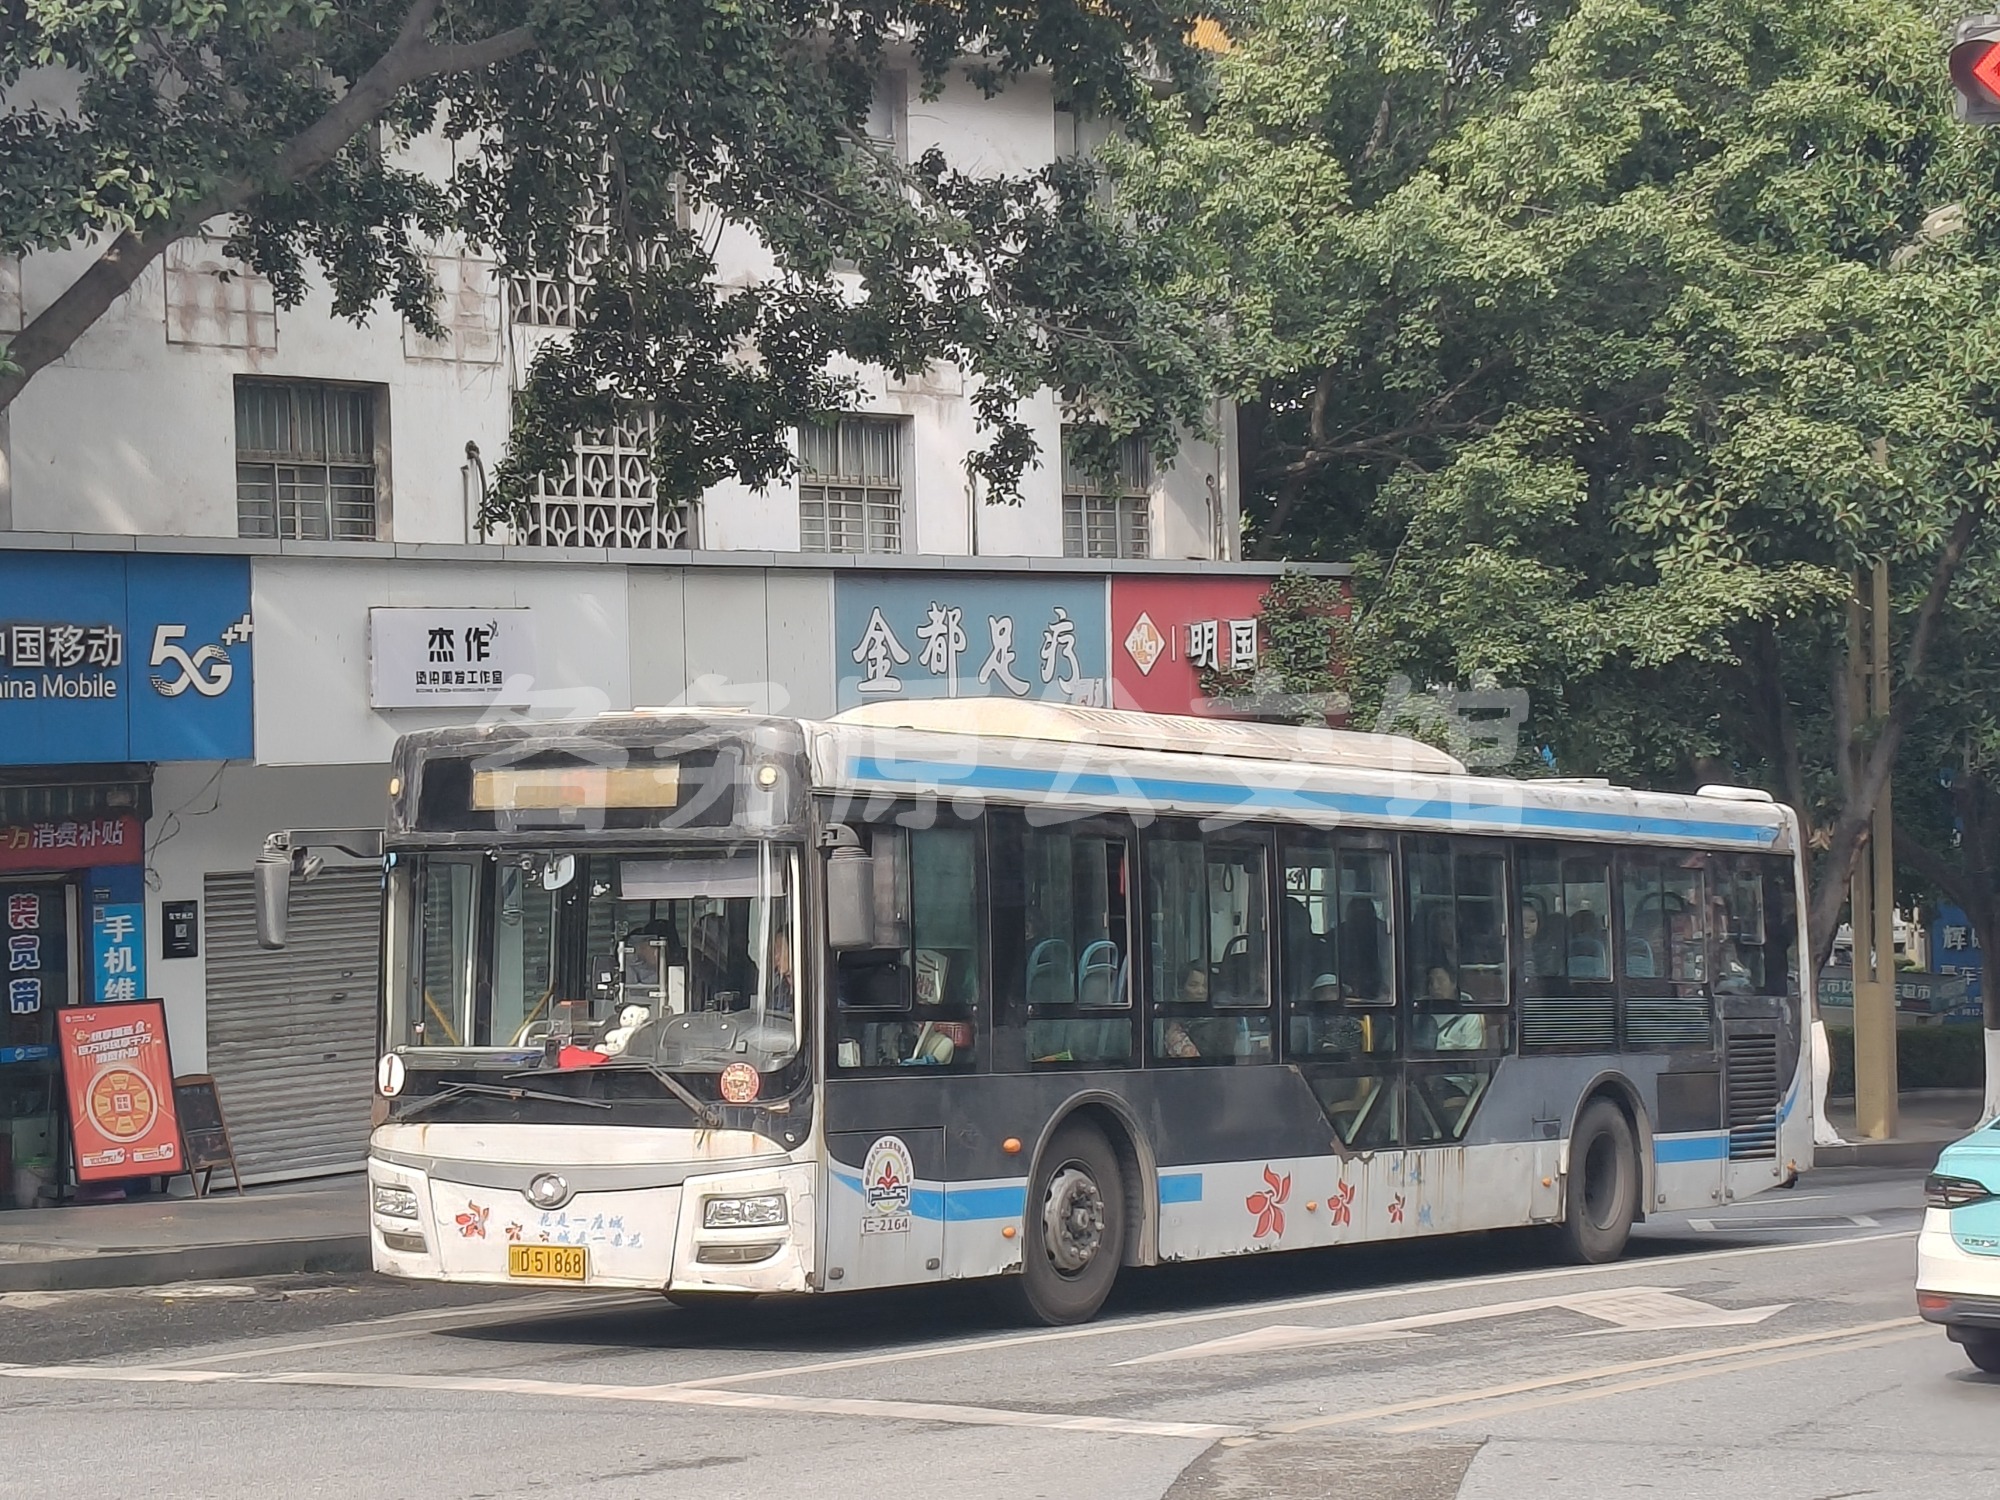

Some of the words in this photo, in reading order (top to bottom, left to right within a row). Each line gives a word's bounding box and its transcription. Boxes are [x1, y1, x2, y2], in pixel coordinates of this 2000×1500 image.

[428, 626, 491, 663] 杰作
[851, 600, 1082, 698] 金都足疗
[42, 672, 117, 699] Mobile
